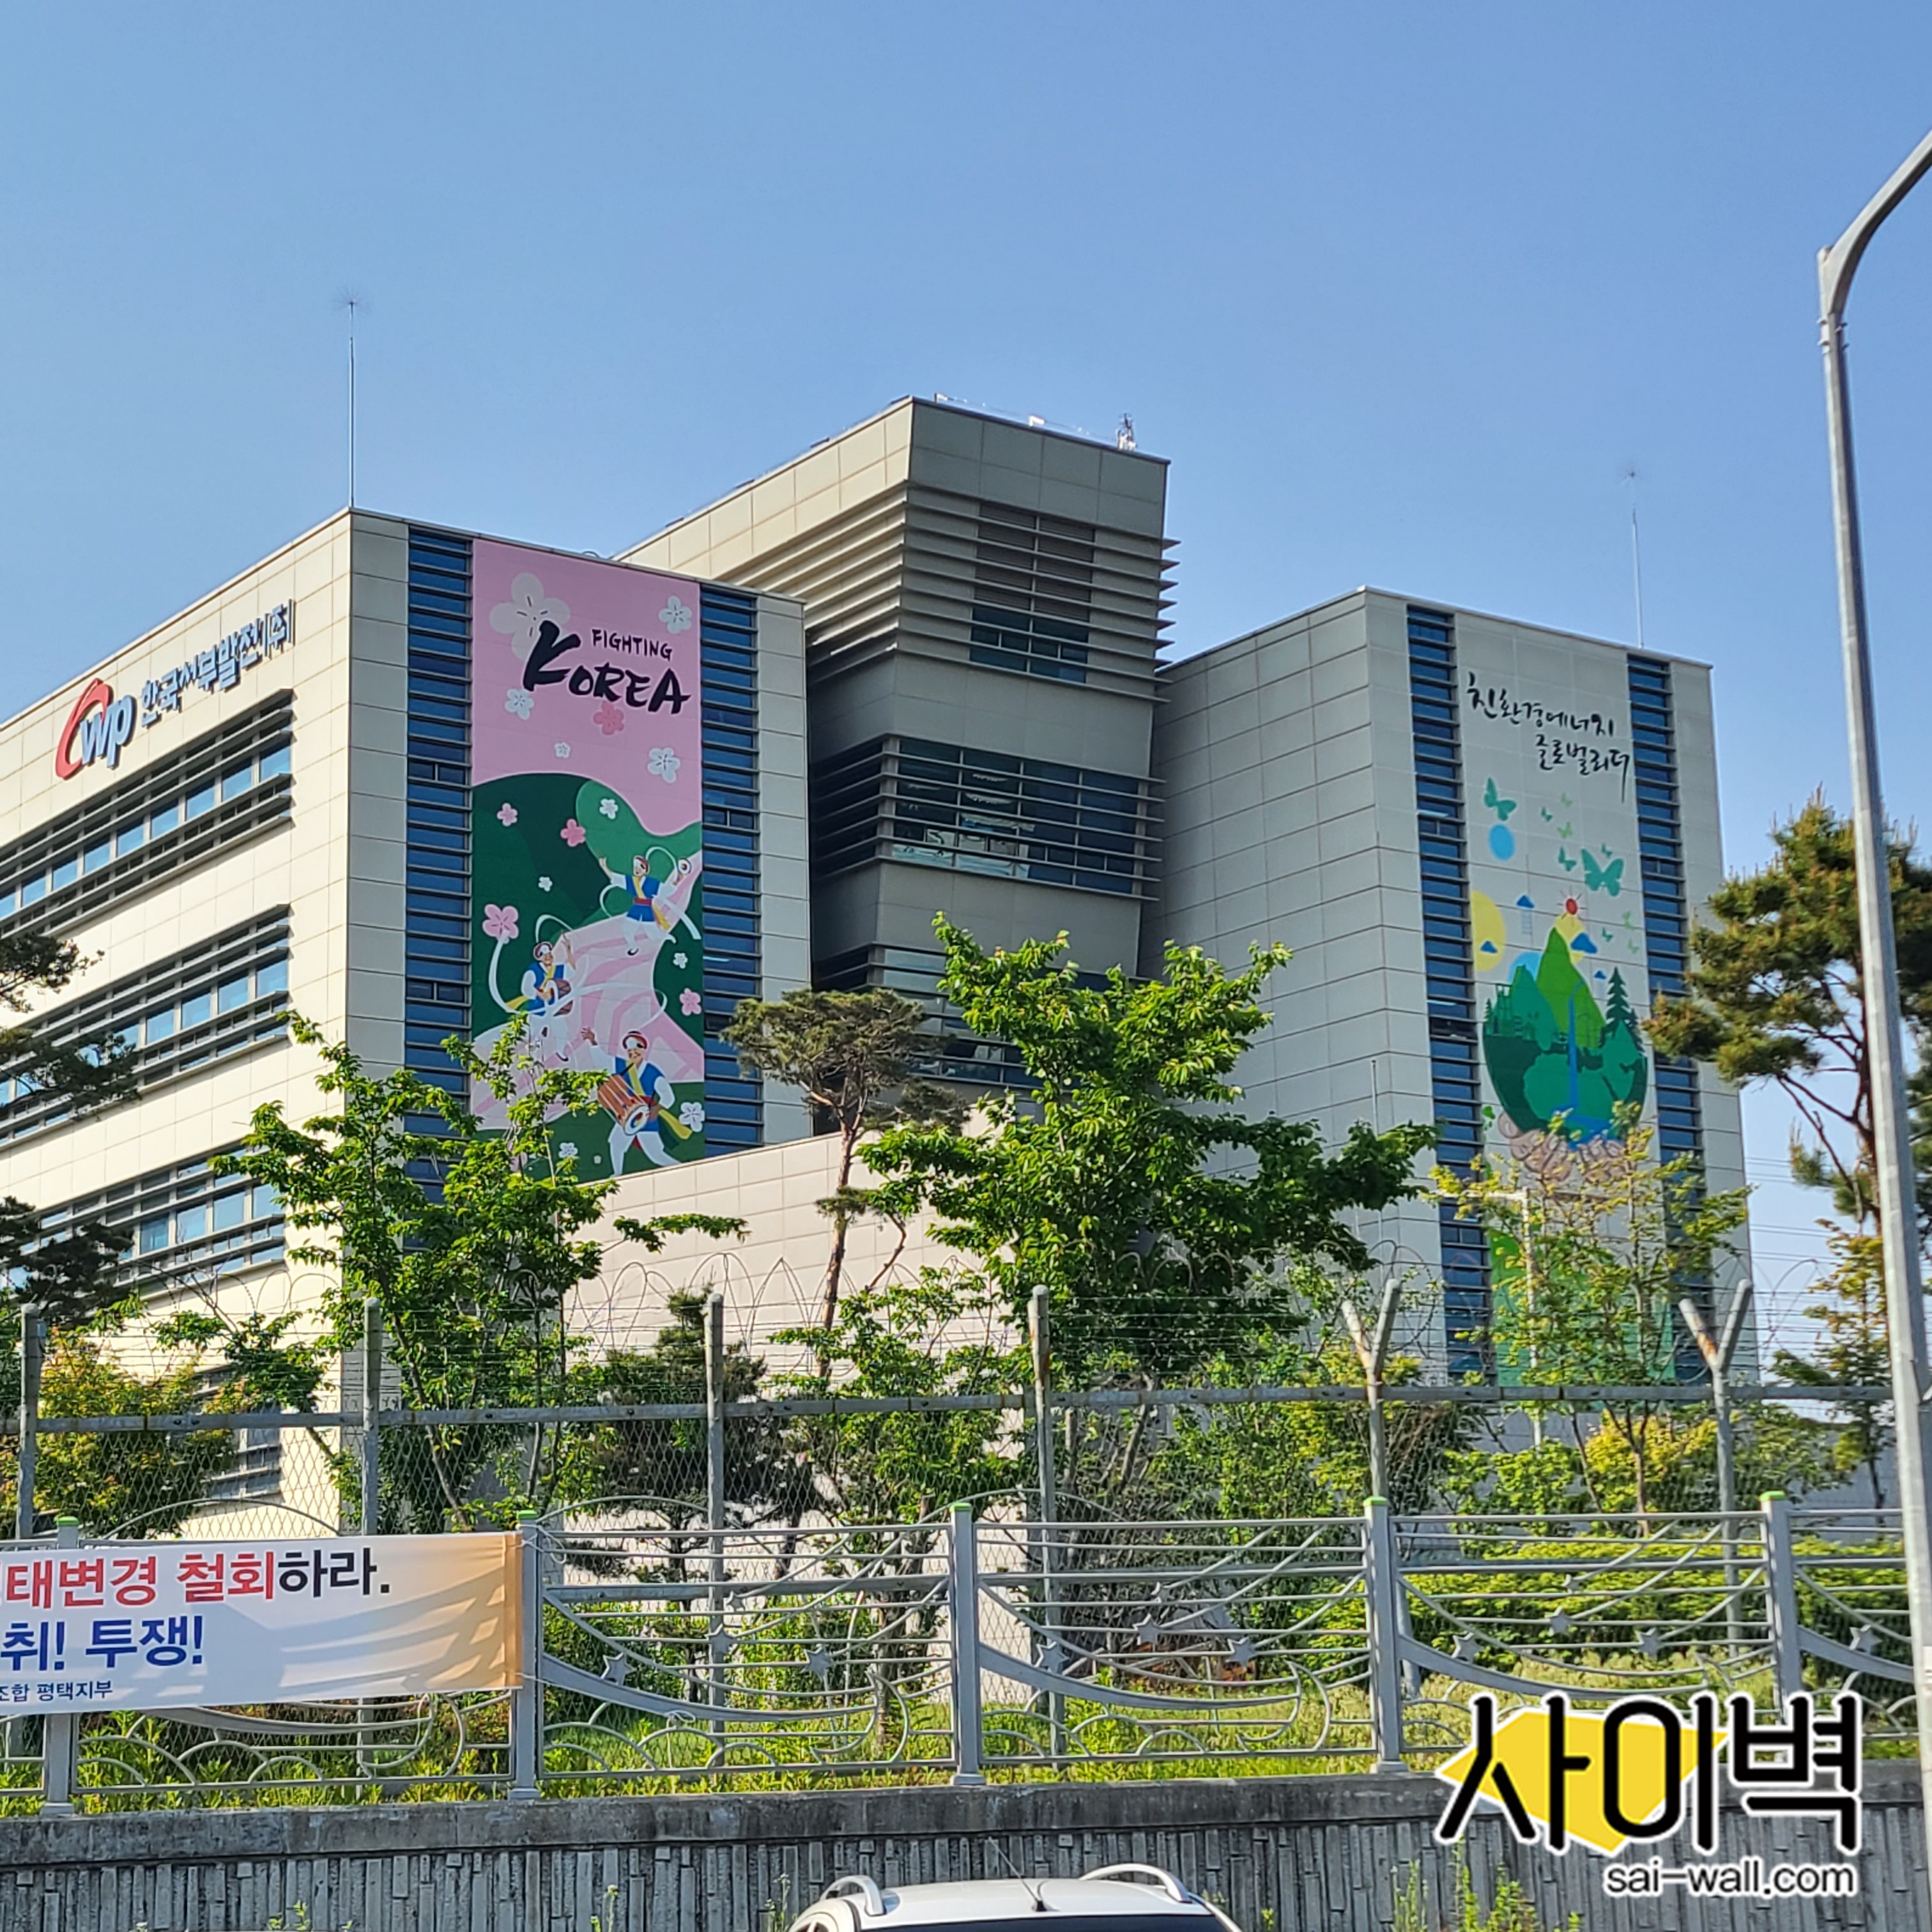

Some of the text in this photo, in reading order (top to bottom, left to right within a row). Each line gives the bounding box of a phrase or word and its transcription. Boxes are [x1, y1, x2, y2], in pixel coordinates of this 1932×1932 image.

[523, 620, 691, 714] KOREA
[591, 629, 673, 661] FIGHTING
[1467, 671, 1614, 736] 친환경에너지
[176, 1547, 390, 1603] 철회하라.
[0, 1615, 203, 1671] 취! 투쟁!
[36, 1680, 113, 1702] 평택지부
